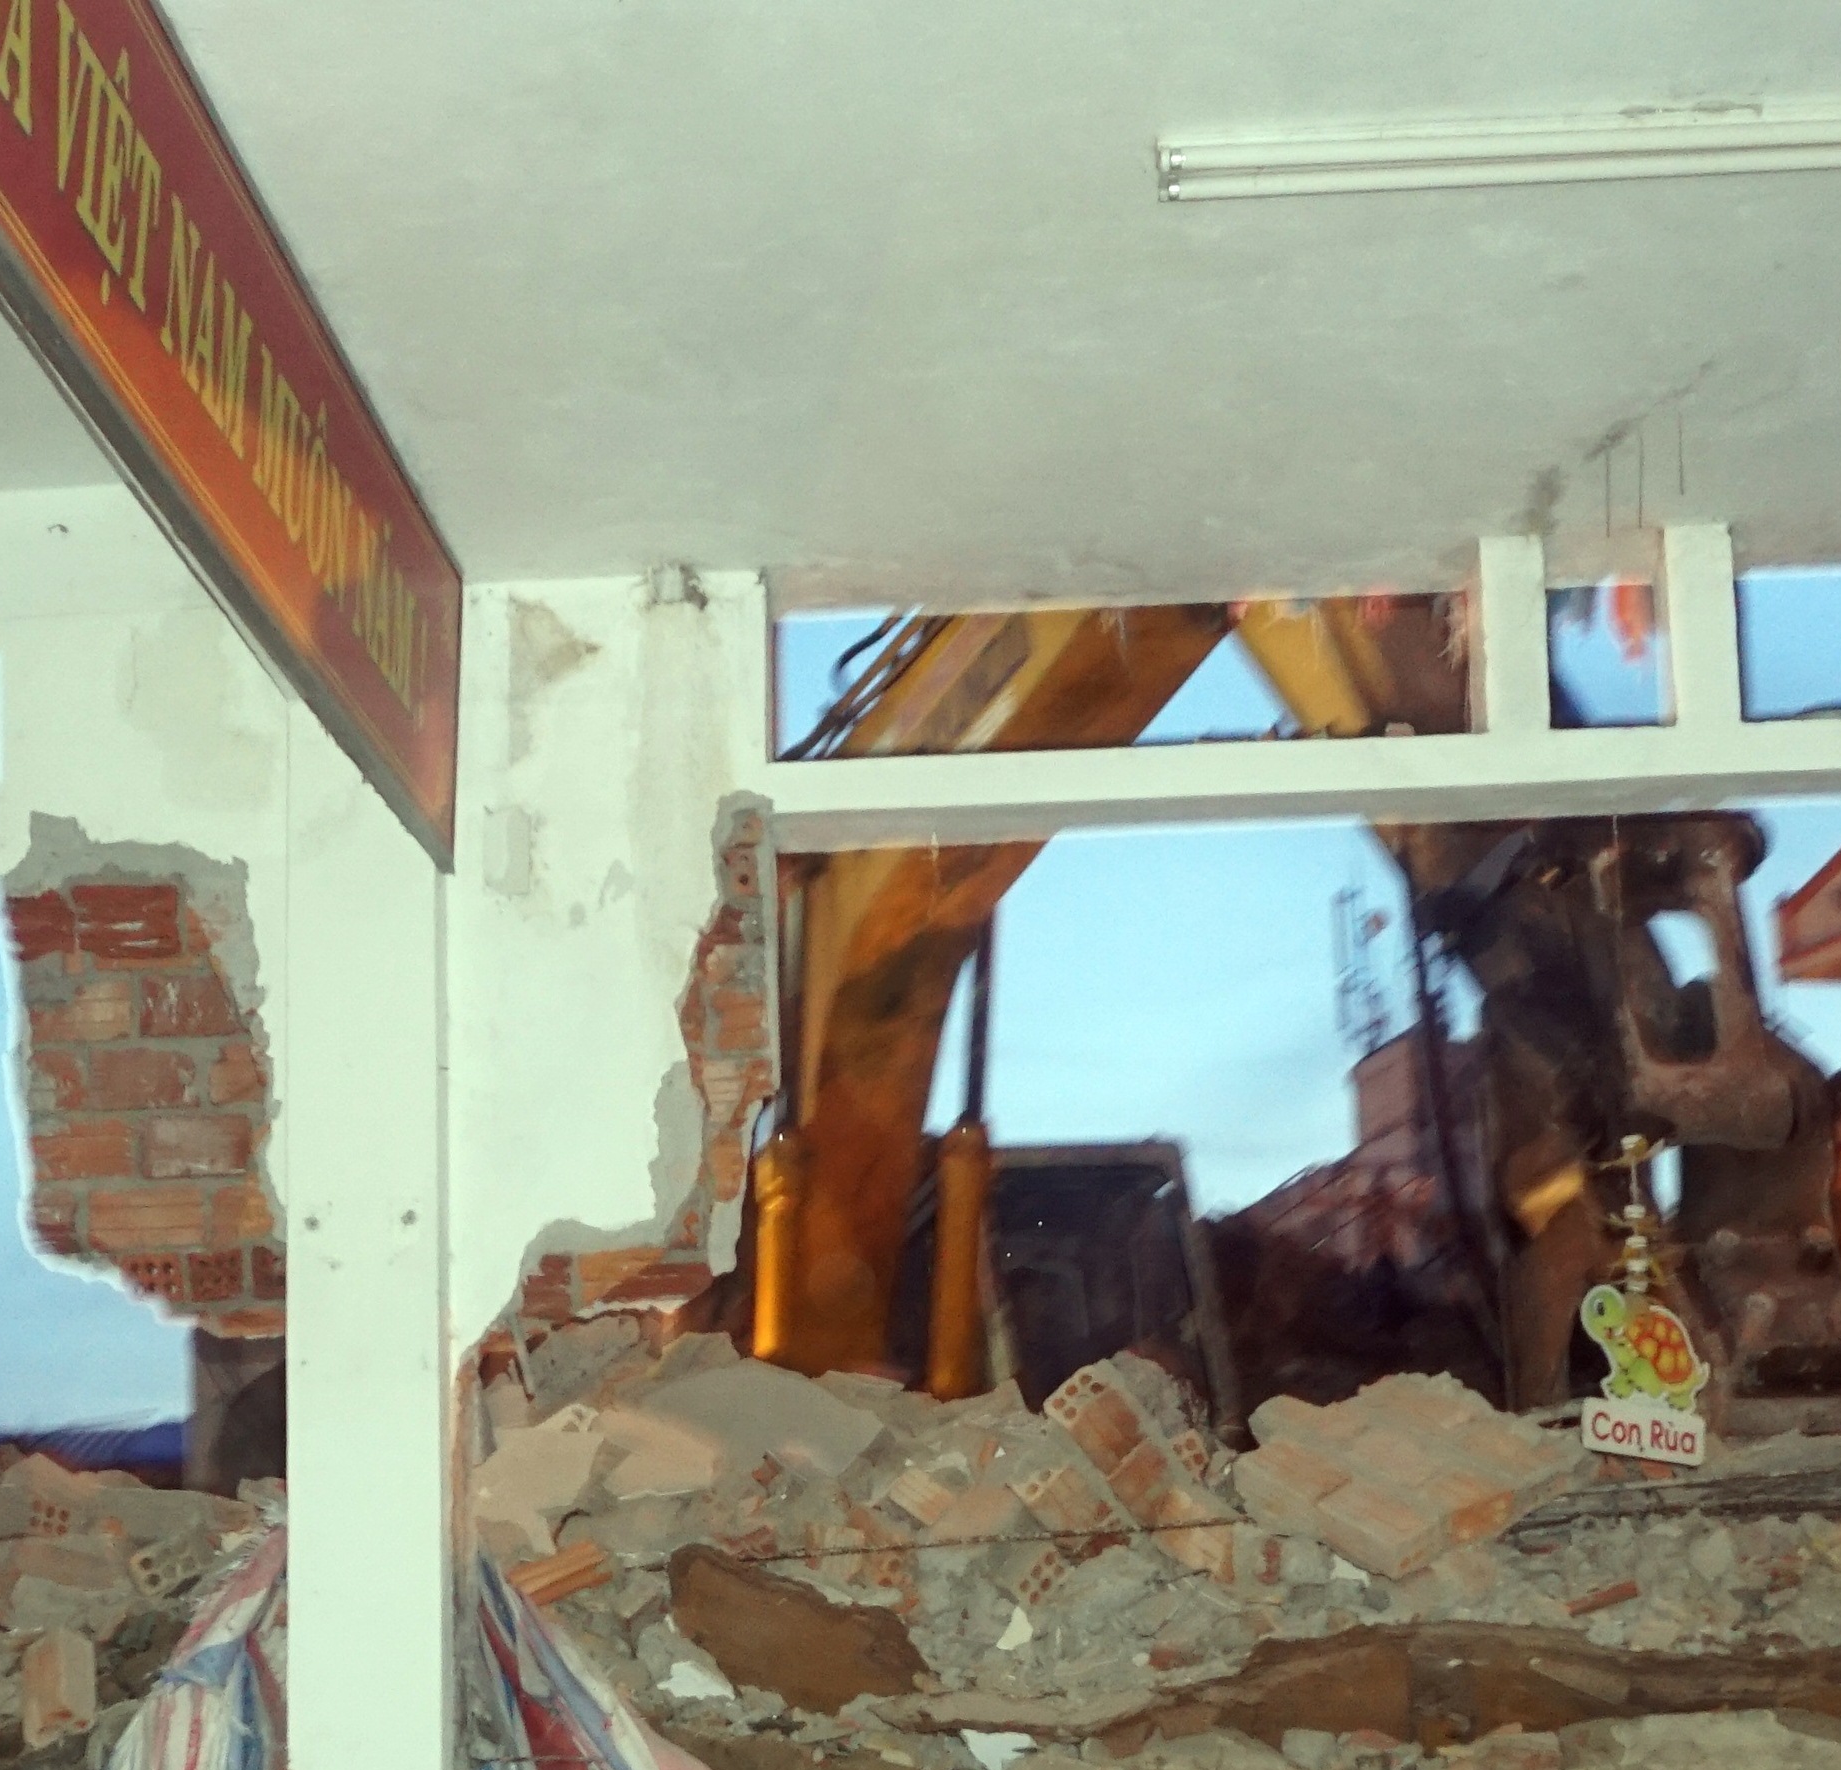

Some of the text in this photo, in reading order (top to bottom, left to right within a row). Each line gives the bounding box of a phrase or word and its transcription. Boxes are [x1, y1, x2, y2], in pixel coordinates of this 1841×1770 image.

[57, 0, 161, 313] VIỆT
[160, 191, 253, 460] NAM
[253, 343, 352, 612] MUÔN
[1591, 1411, 1696, 1454] Con Rùa
